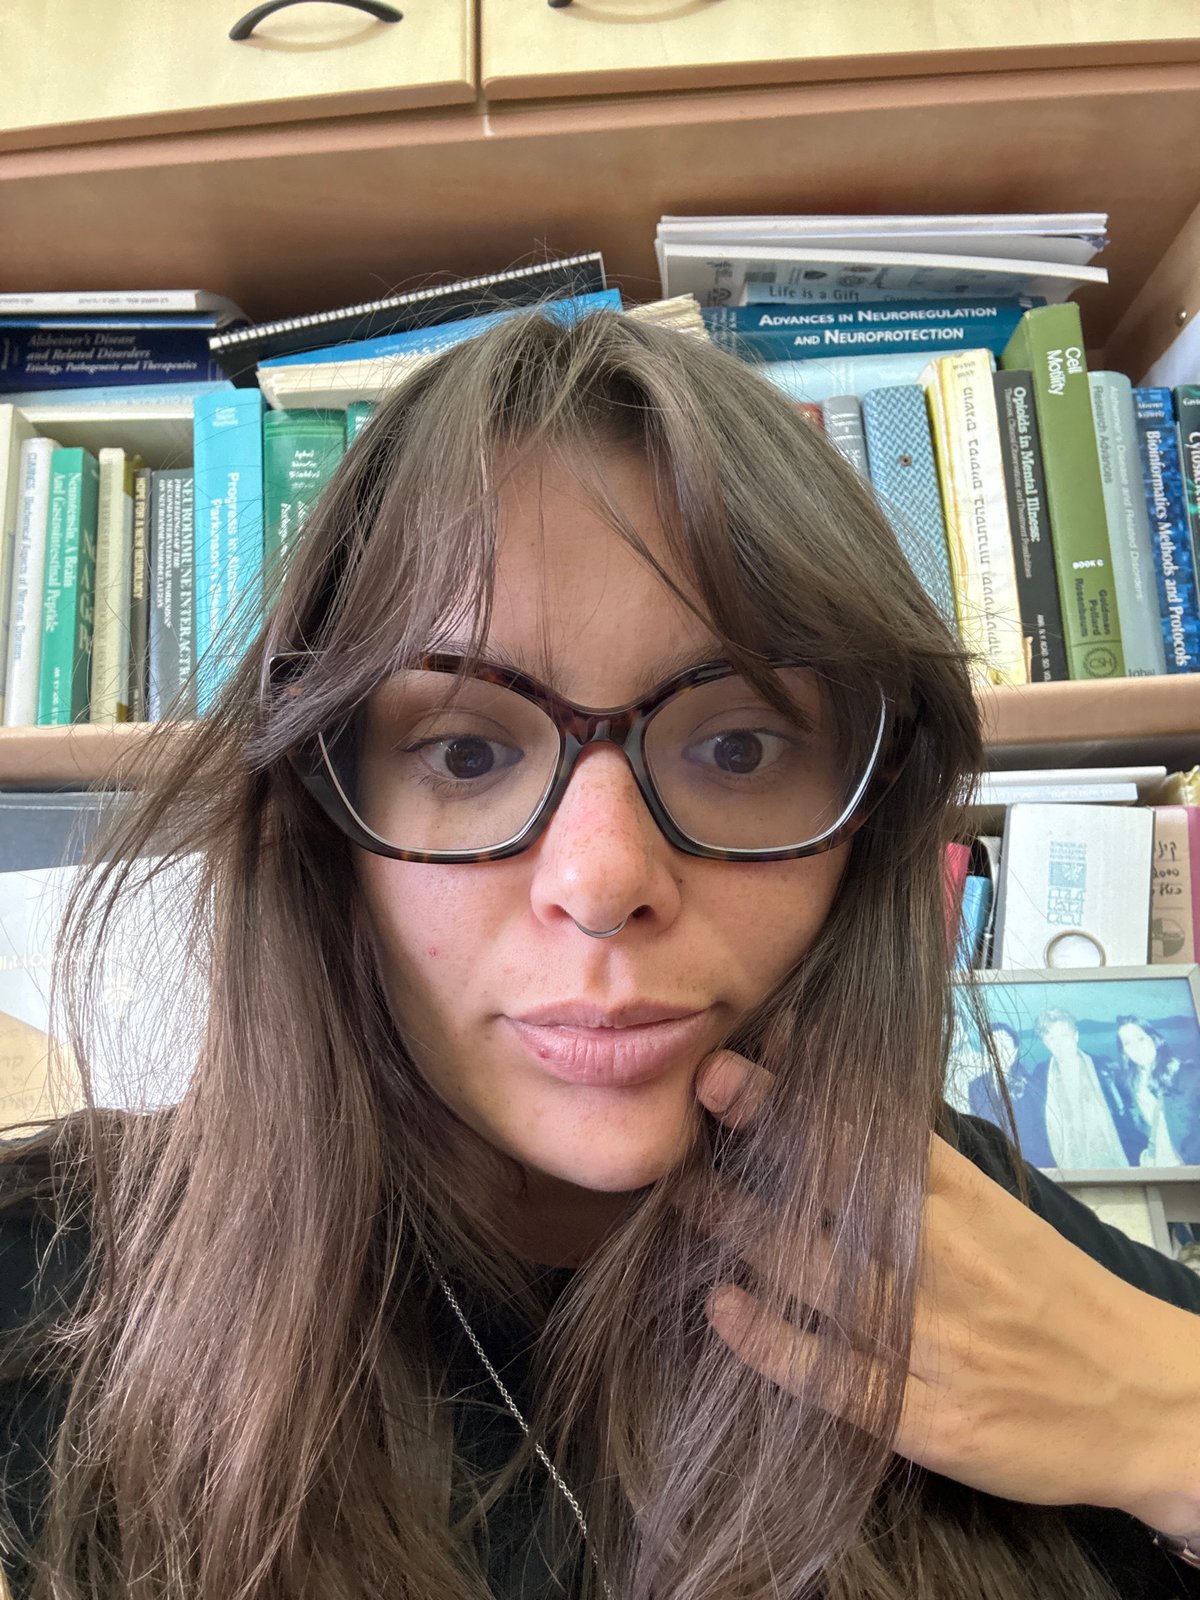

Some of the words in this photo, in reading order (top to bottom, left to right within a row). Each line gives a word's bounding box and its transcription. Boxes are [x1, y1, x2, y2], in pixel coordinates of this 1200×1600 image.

[769, 285, 796, 298] Life
[803, 287, 813, 299] is
[819, 291, 827, 300] a
[833, 289, 861, 302] Gift
[759, 313, 834, 326] ADVANCES
[838, 313, 853, 323] IN
[857, 307, 997, 322] NEUROREGULATION
[27, 350, 49, 360] and
[53, 348, 93, 360] Related
[97, 347, 151, 359] Disorders
[28, 333, 91, 347] Alzheimer's
[94, 333, 136, 346] Disease
[794, 335, 820, 346] AND
[824, 328, 964, 345] NEUROPROTECTION
[65, 362, 120, 375] Pathogenesis
[121, 361, 140, 371] and
[142, 360, 198, 374] Therapeutics
[1046, 349, 1065, 396] Motility
[1063, 346, 1082, 376] Cell
[1012, 386, 1028, 433] Opioids
[1093, 385, 1108, 433] Research
[1019, 436, 1031, 449] in
[1100, 435, 1114, 484] Advances
[53, 472, 67, 495] And
[1021, 452, 1037, 495] Mental
[1116, 445, 1130, 485] Disease
[1145, 430, 1169, 519] Bioinformatics
[134, 501, 146, 518] FOR
[224, 472, 240, 534] Progress
[1122, 487, 1133, 506] and
[134, 519, 145, 527] A
[134, 527, 145, 548] NEW
[1026, 497, 1041, 543] Illness:
[1125, 509, 1139, 548] Related
[48, 497, 67, 587] Gastrointestinal
[65, 544, 78, 554] A
[1157, 522, 1179, 577] Methods
[63, 556, 78, 588] Brain
[132, 548, 145, 599] NEUROLOGY
[1166, 579, 1184, 602] and
[44, 589, 61, 633] Peptide
[1074, 578, 1089, 638] Rosenbaum
[1088, 599, 1101, 636] Pollard
[1098, 589, 1111, 635] Goldman
[1169, 606, 1192, 667] Protocols
